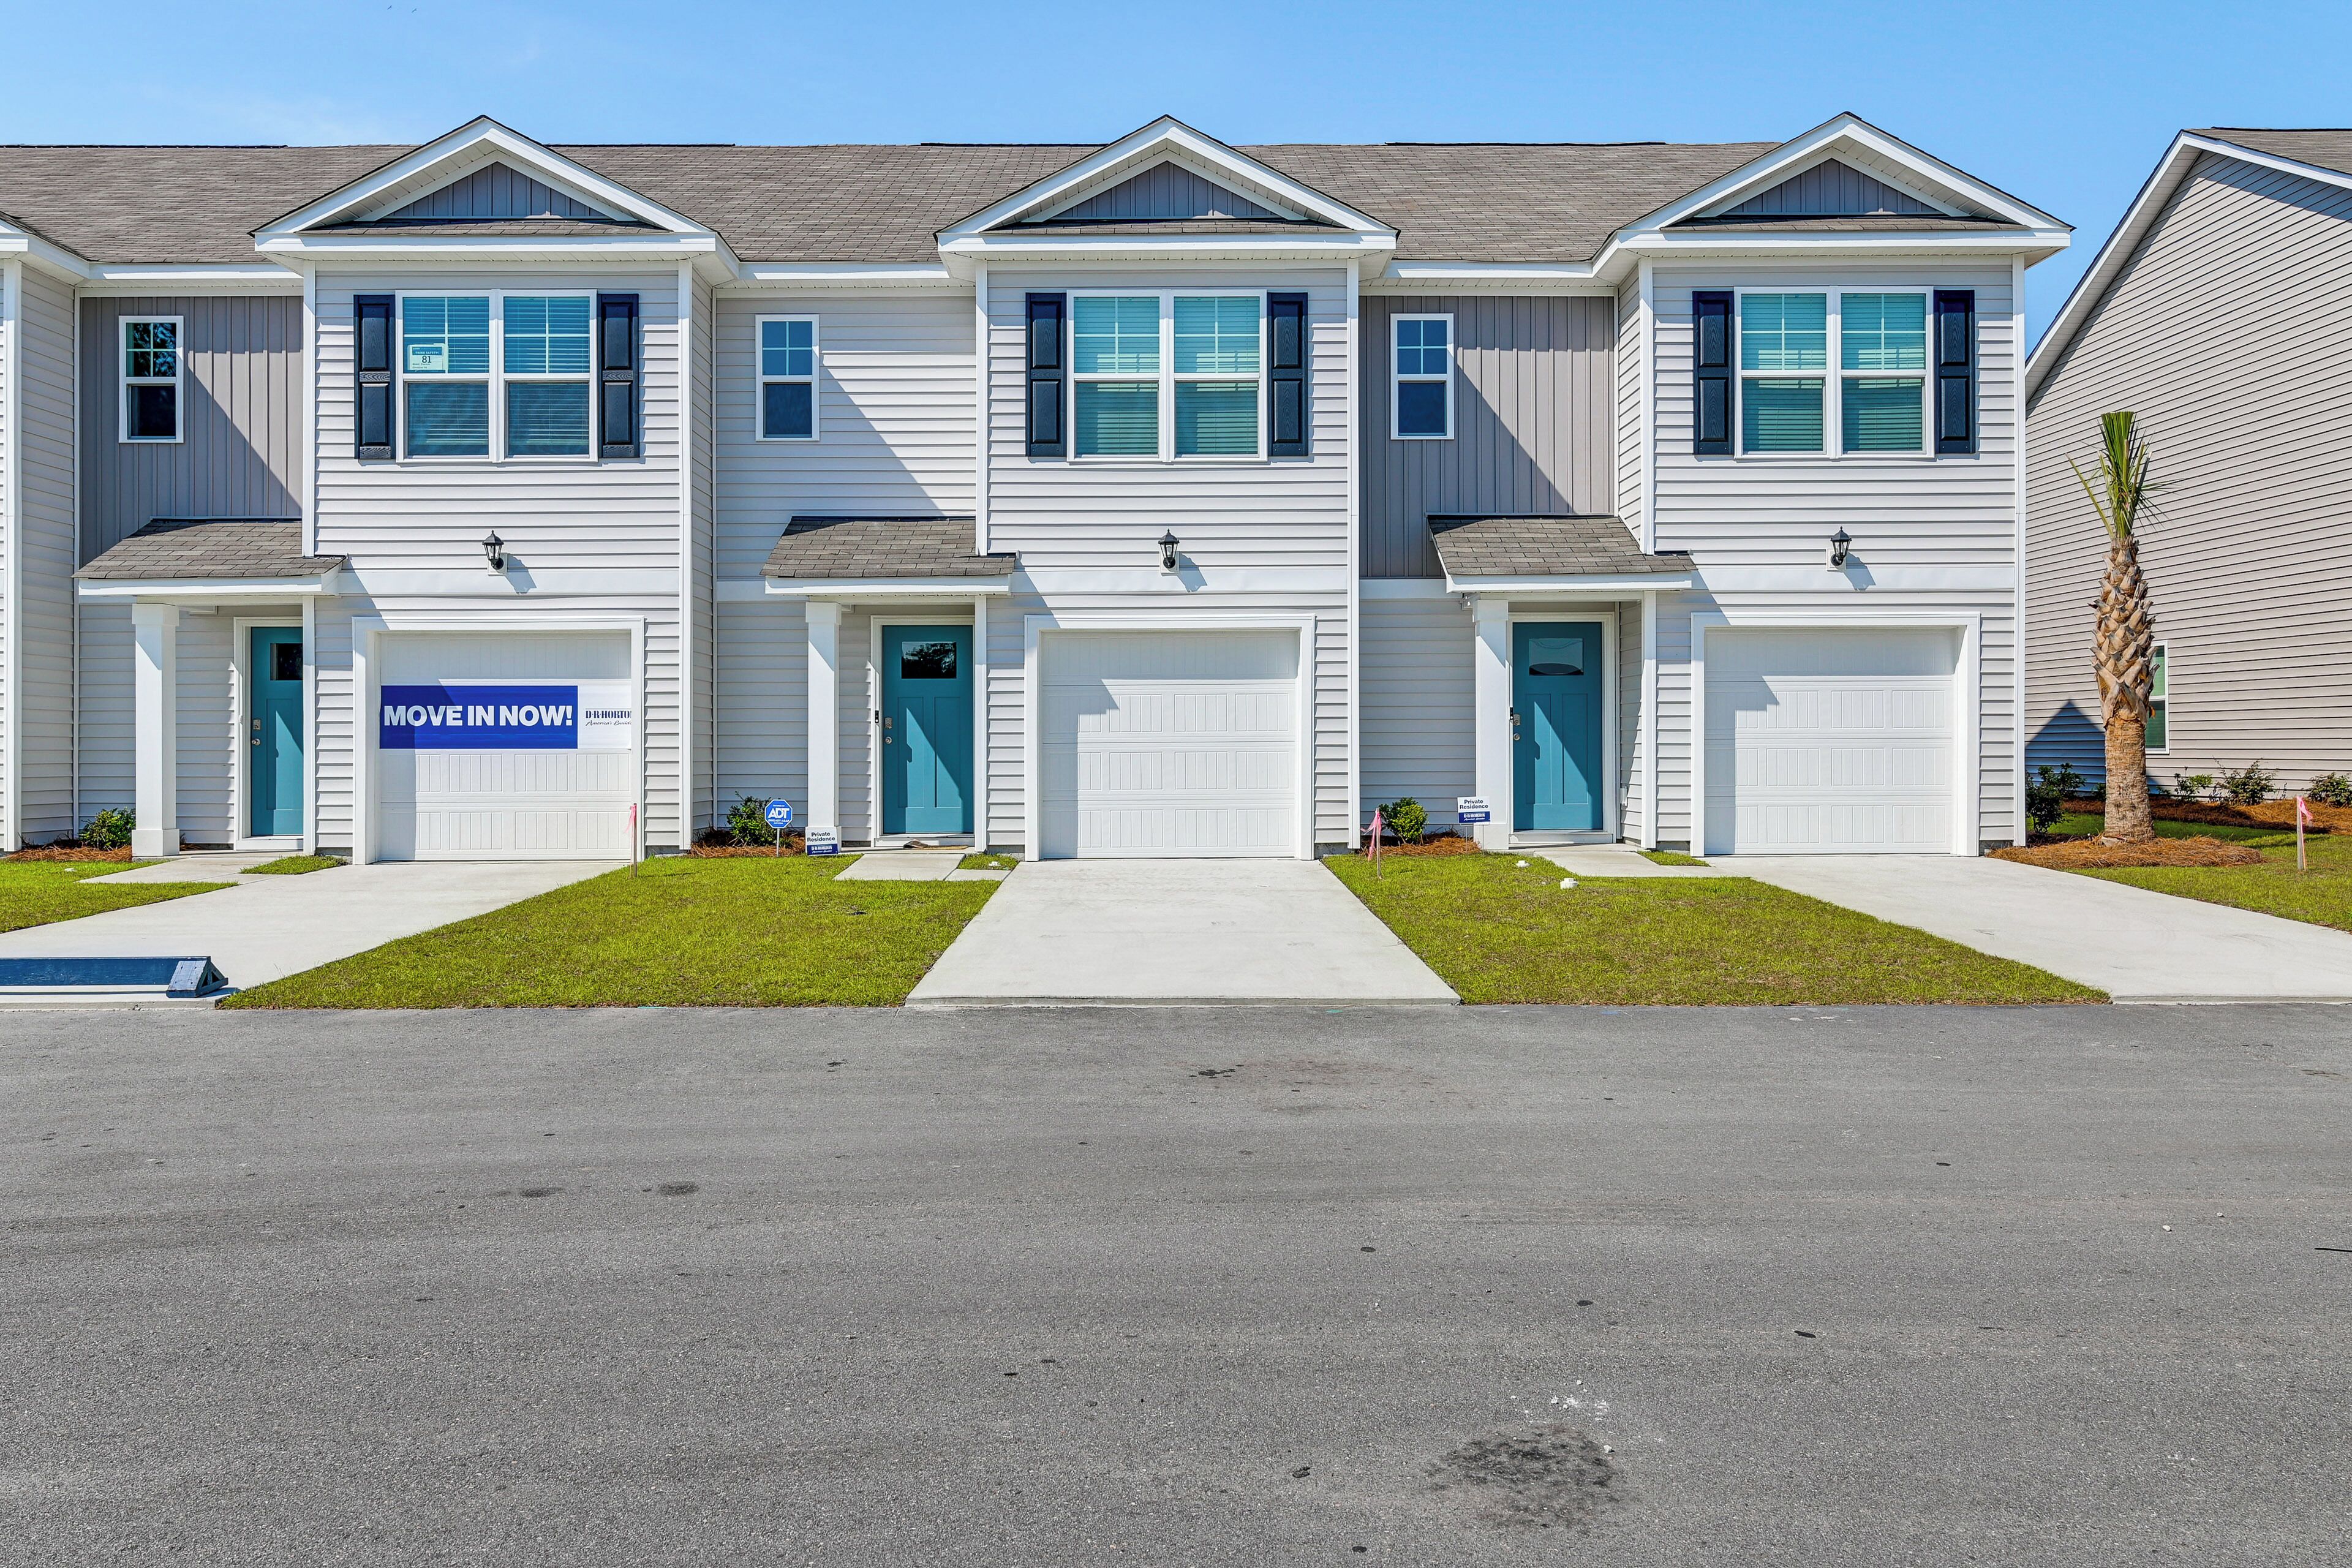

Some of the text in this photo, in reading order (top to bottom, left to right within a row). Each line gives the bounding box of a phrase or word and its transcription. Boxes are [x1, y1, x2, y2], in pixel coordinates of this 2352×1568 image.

[384, 705, 573, 726] MOVE IN NOW!
[586, 710, 631, 718] D·R·HORTO
[767, 807, 790, 819] ADT
